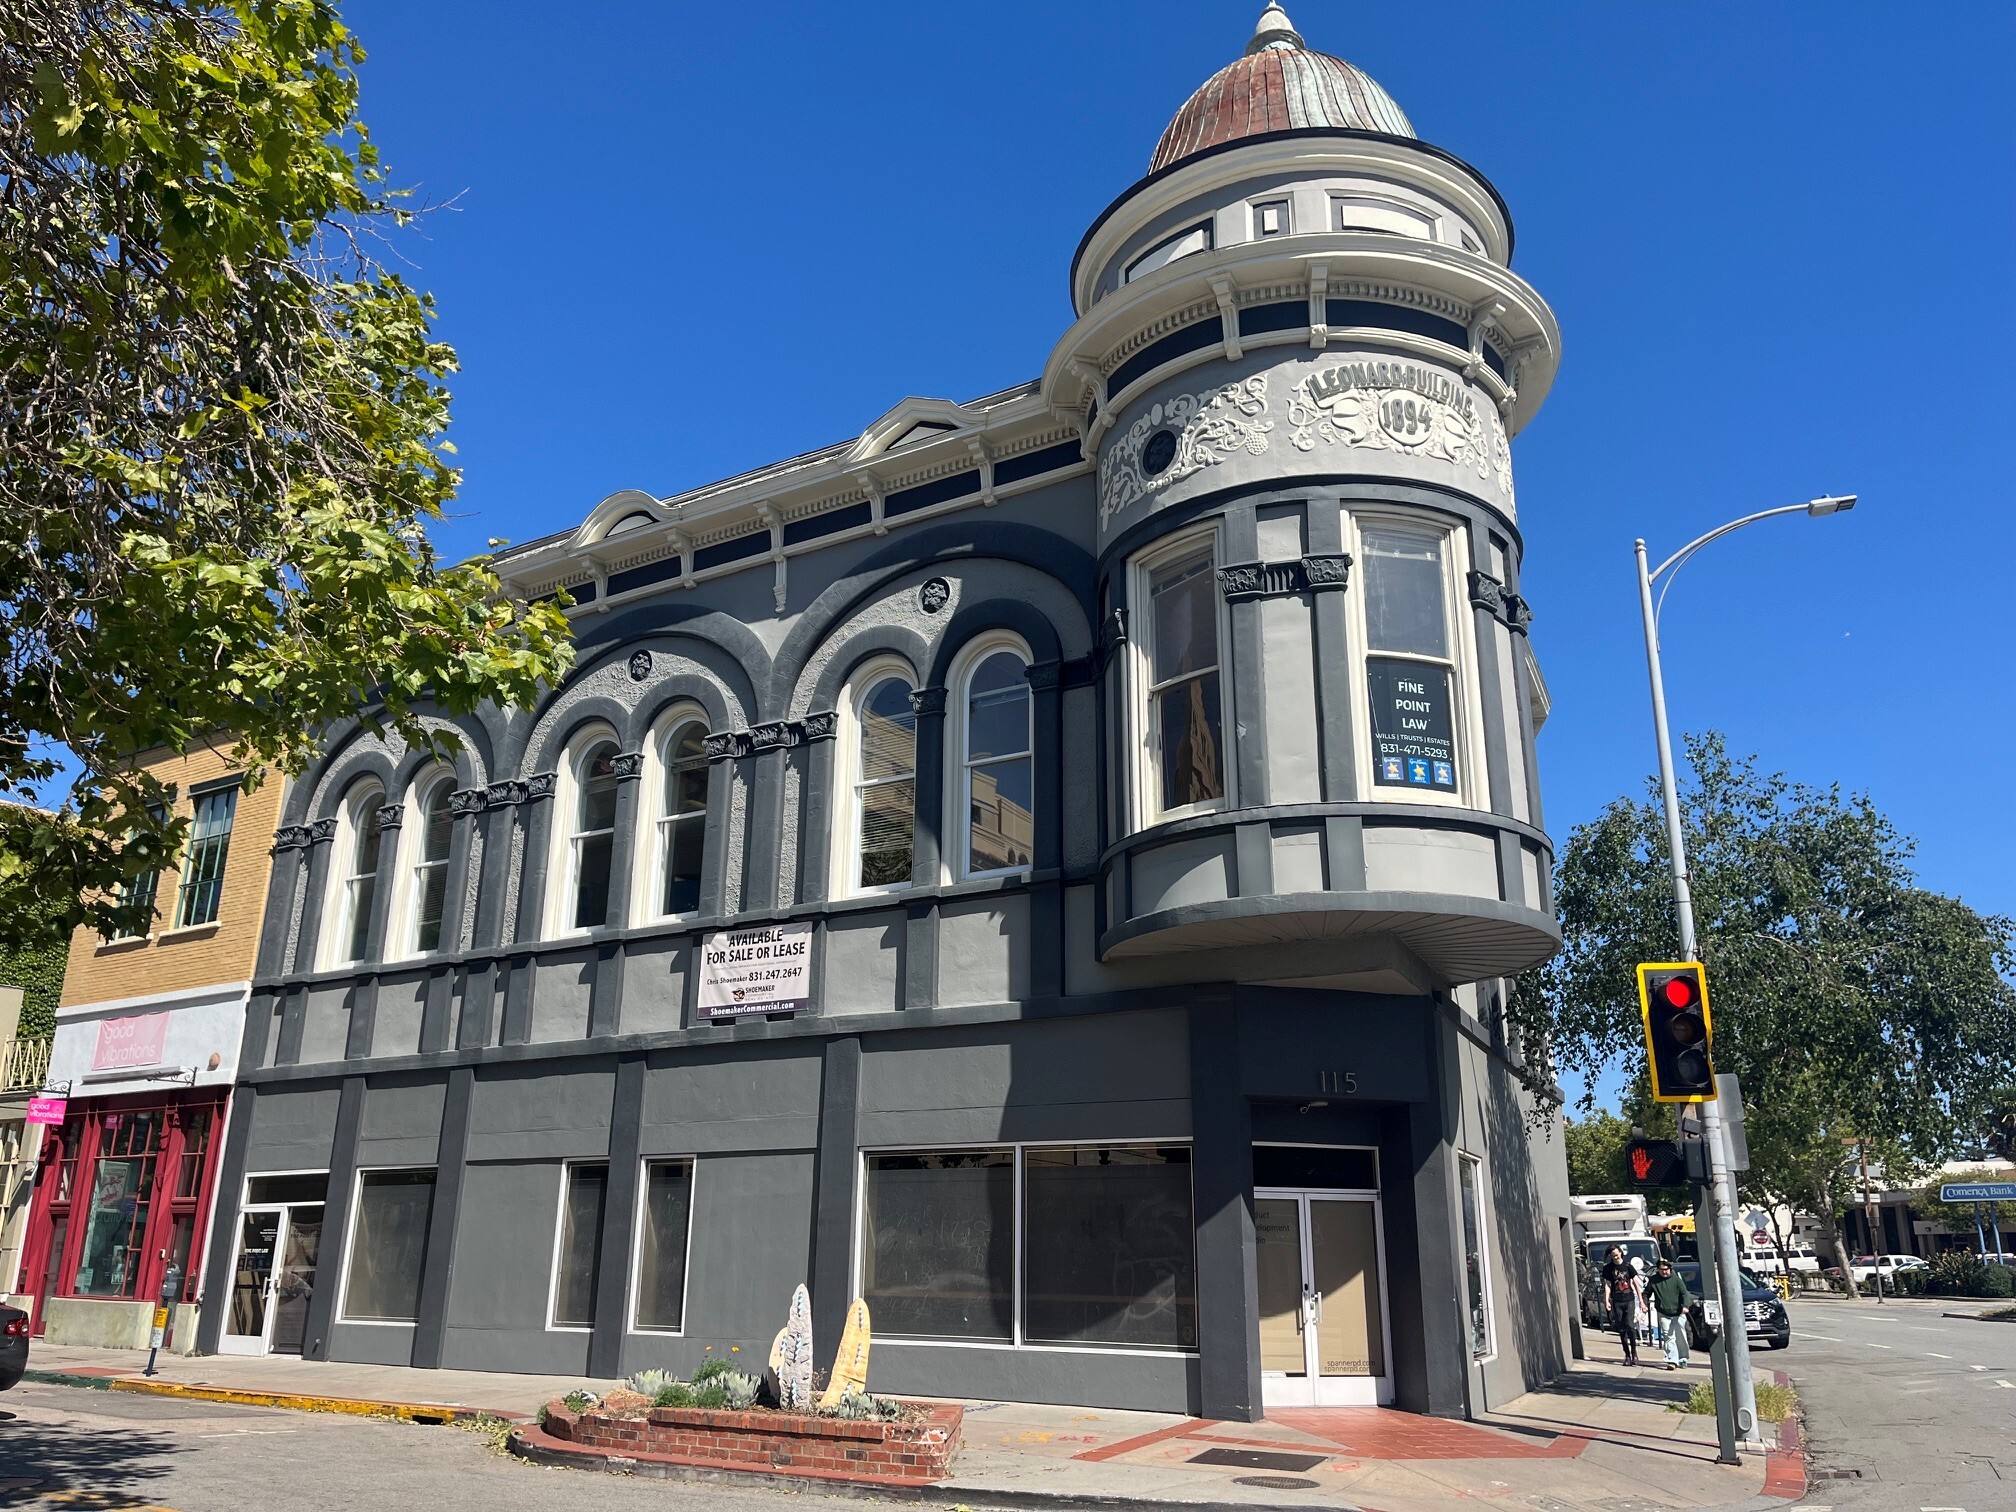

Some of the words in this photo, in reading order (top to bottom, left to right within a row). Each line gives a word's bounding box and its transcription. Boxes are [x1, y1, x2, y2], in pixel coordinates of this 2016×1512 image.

[1306, 362, 1404, 400] LEONARD
[1406, 364, 1475, 419] BUILDING
[1381, 399, 1433, 435] 1894
[1398, 681, 1425, 694] FINE
[1395, 699, 1431, 713] POINT
[1402, 718, 1428, 730] LAW
[1401, 734, 1424, 742] TRUSTS
[1427, 737, 1450, 746] ESTATES
[1381, 743, 1448, 759] 831-471-5293
[729, 929, 783, 947] AVAILABLE
[707, 951, 726, 965] FOR
[729, 948, 753, 962] SALE
[756, 946, 770, 959] OR
[773, 941, 805, 957] LEASE
[720, 975, 747, 984] Shoemaker
[748, 967, 802, 982] 831.247.2647
[745, 984, 776, 994] SHOEMAKER
[710, 1001, 794, 1016] ShoemakerCommercial.com
[105, 1021, 135, 1044] good
[102, 1043, 156, 1062] vibrations
[1321, 1070, 1357, 1094] 115
[29, 1110, 64, 1119] vibrations
[1990, 1186, 2013, 1195] Bank
[1254, 1211, 1270, 1219] duct
[1255, 1224, 1290, 1233] elopment
[1327, 1359, 1376, 1367] spannerpd.com
